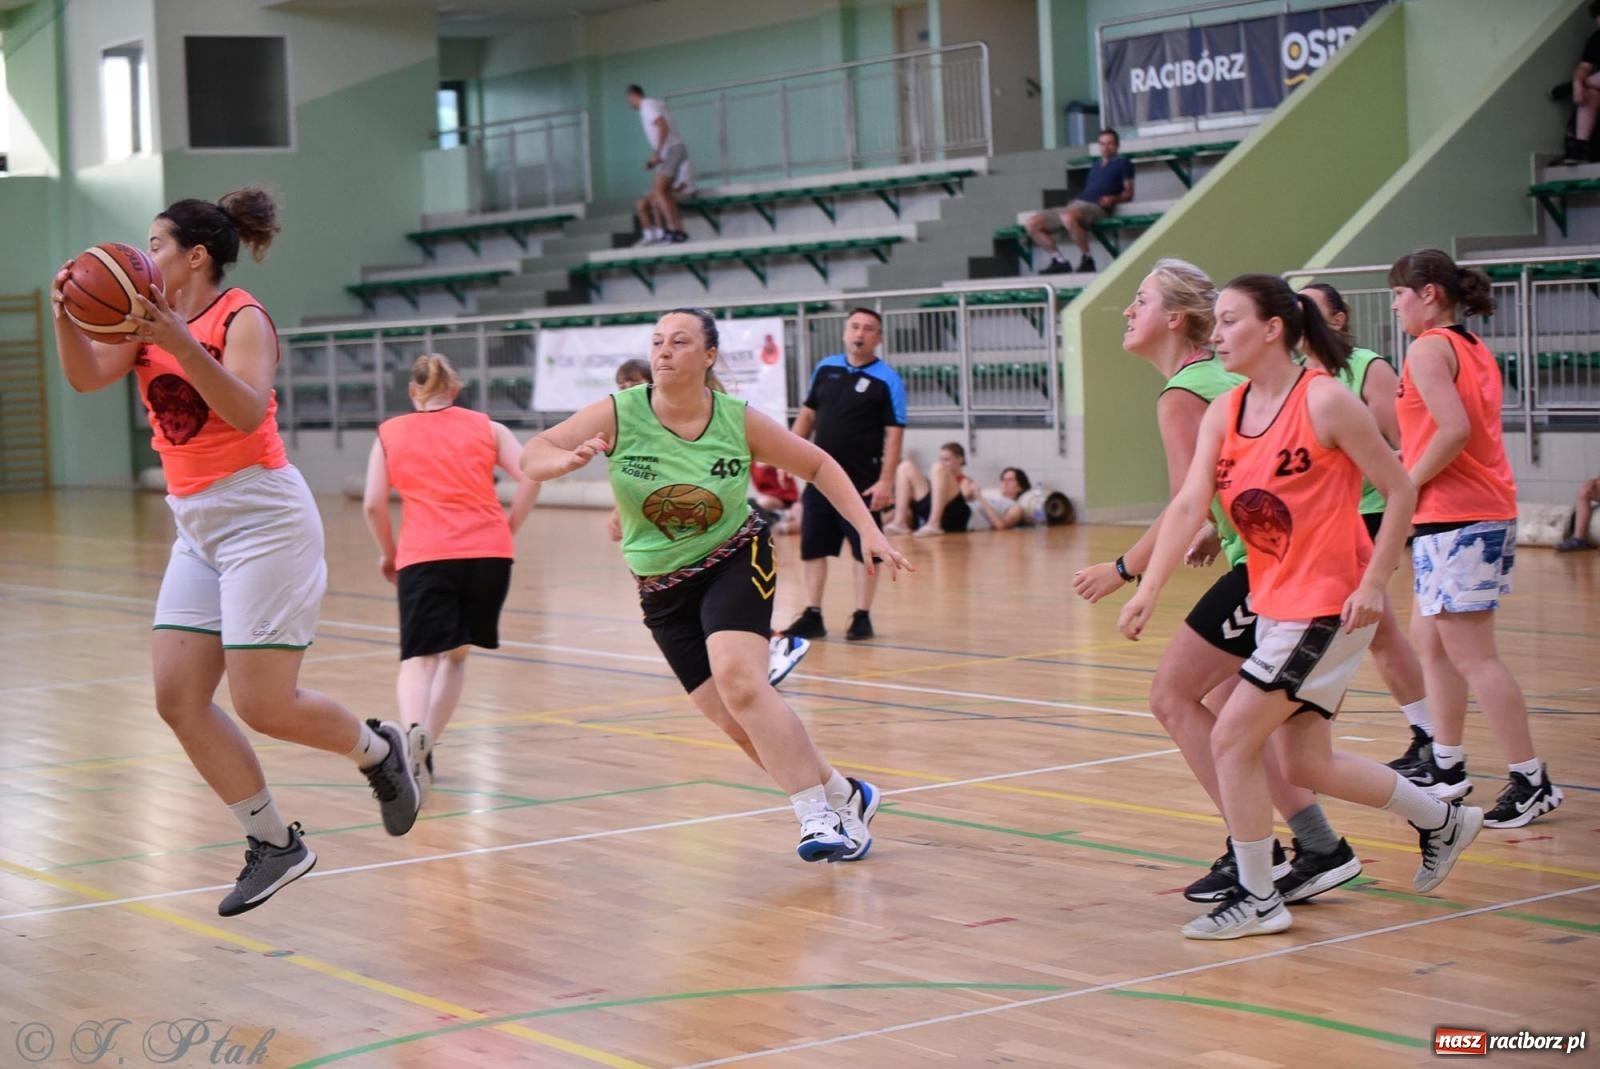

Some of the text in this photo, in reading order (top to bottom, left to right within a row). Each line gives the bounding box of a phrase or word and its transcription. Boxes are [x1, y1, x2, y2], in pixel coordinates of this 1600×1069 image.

[1130, 50, 1246, 94] RACIBÓRZ
[621, 466, 658, 482] KOBIET
[710, 457, 742, 479] 40
[1275, 447, 1311, 477] 23
